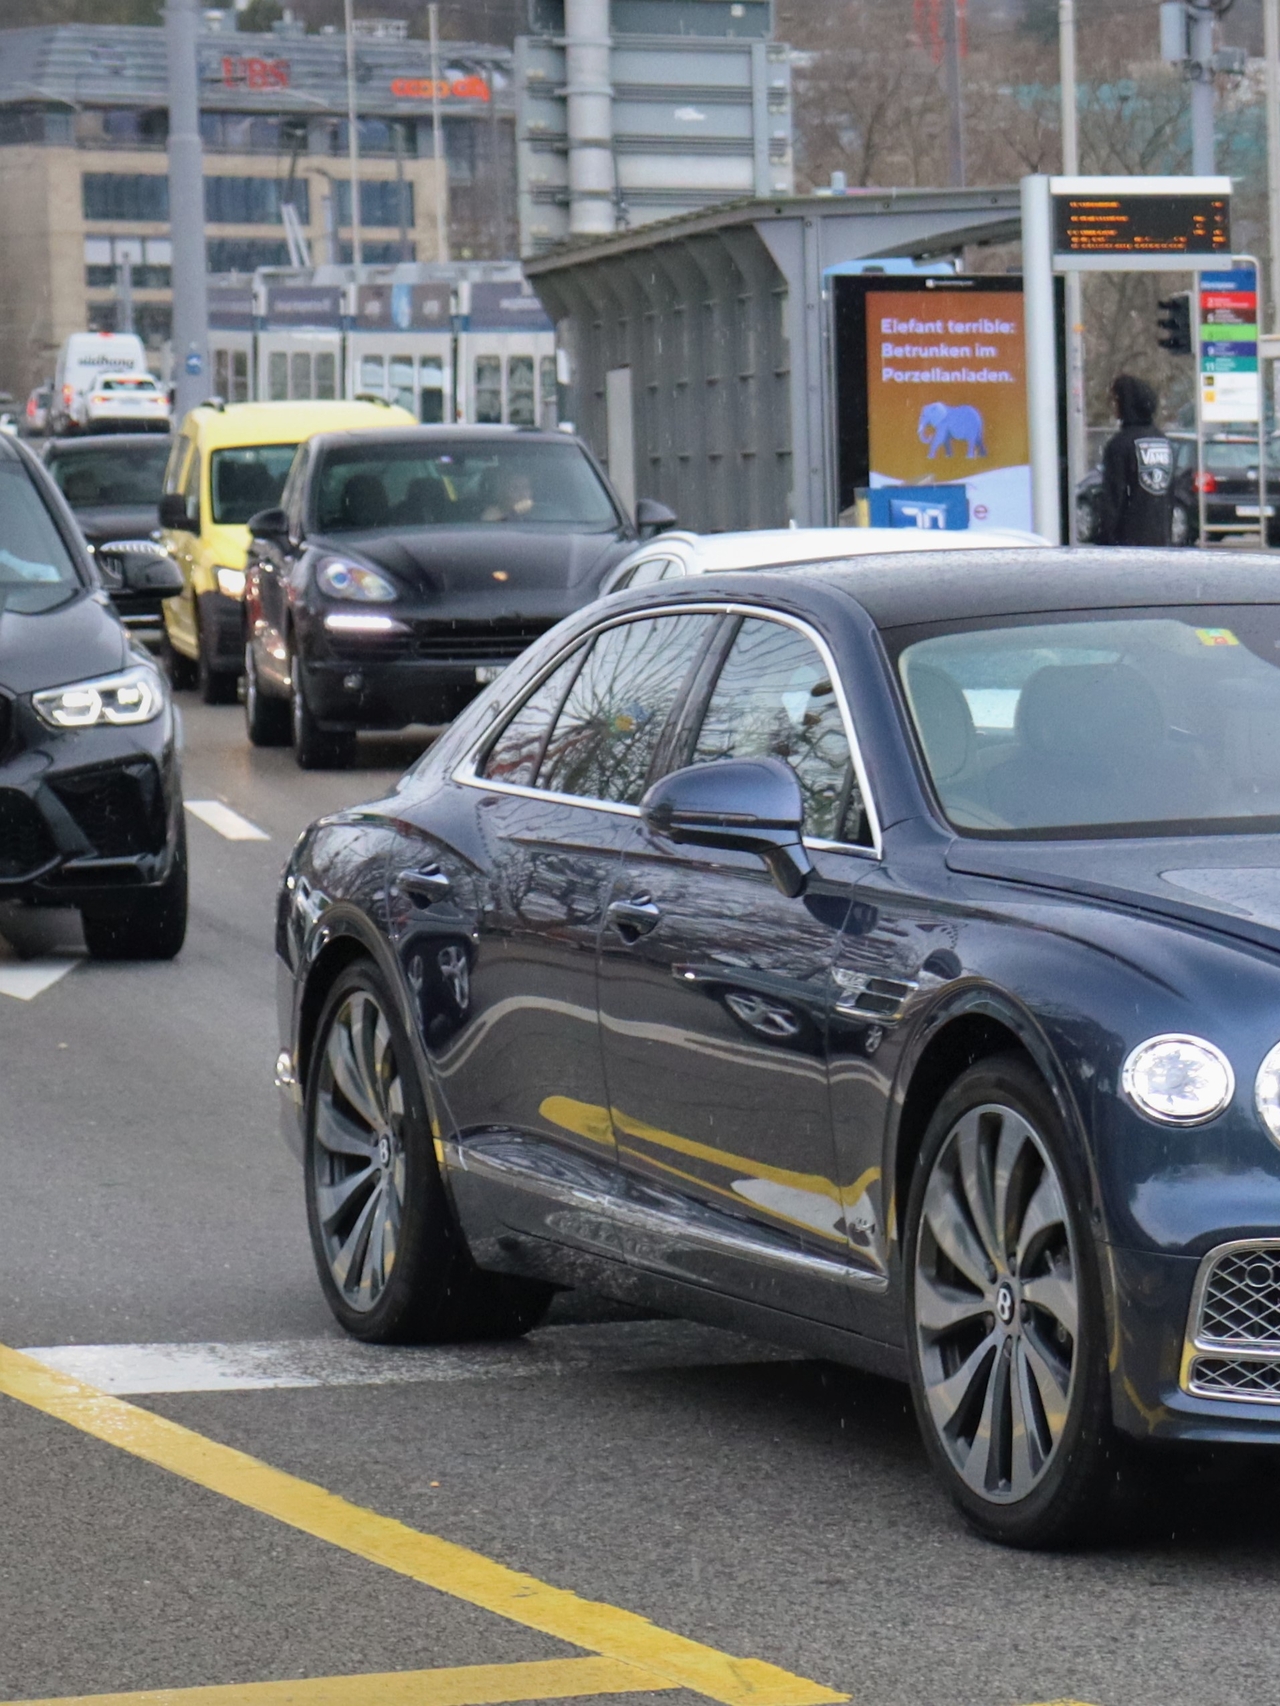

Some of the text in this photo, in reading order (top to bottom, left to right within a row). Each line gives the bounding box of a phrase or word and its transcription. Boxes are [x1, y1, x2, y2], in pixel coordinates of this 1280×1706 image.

[881, 318, 1016, 334] Elefant terrible:
[881, 343, 997, 358] Betrunken im
[882, 367, 1015, 383] Porzellanladen.
[1140, 448, 1169, 465] VANS
